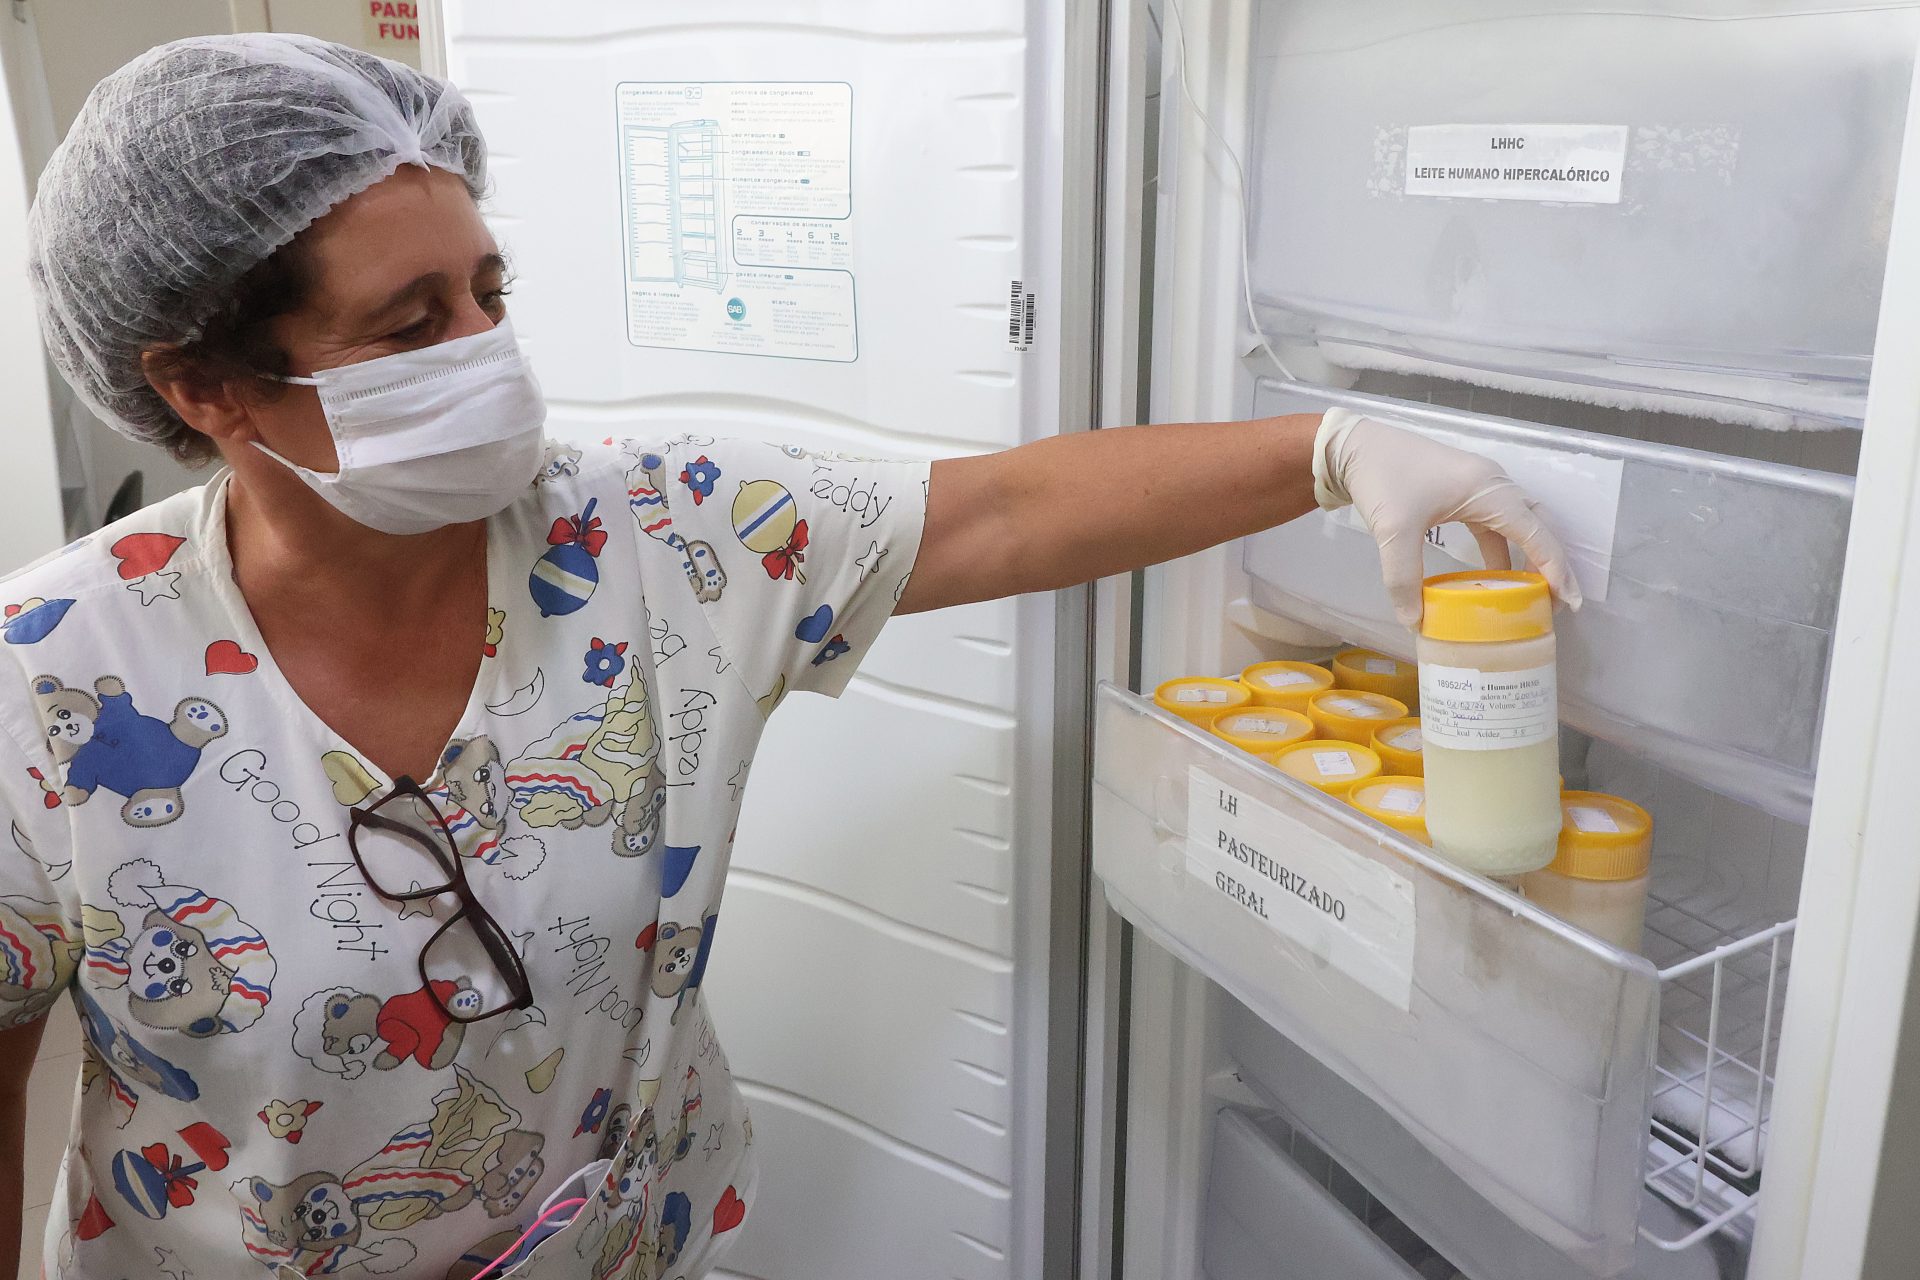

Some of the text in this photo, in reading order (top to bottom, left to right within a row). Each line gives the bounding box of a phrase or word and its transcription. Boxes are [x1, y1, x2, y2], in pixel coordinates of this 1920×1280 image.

[1491, 137, 1524, 150] LHHC
[1414, 166, 1610, 182] LEITE HUMANO HIPERCALÓRICO
[758, 229, 764, 237] 3
[808, 231, 814, 239] 6
[830, 232, 840, 240] 12
[1487, 683, 1518, 691] Humano
[1489, 702, 1516, 710] Volume
[1218, 789, 1238, 818] LH
[219, 748, 389, 961] Good Night
[1217, 829, 1345, 921] PASTEURIZADO
[1215, 870, 1269, 920] GERAL
[547, 915, 611, 997] Night
